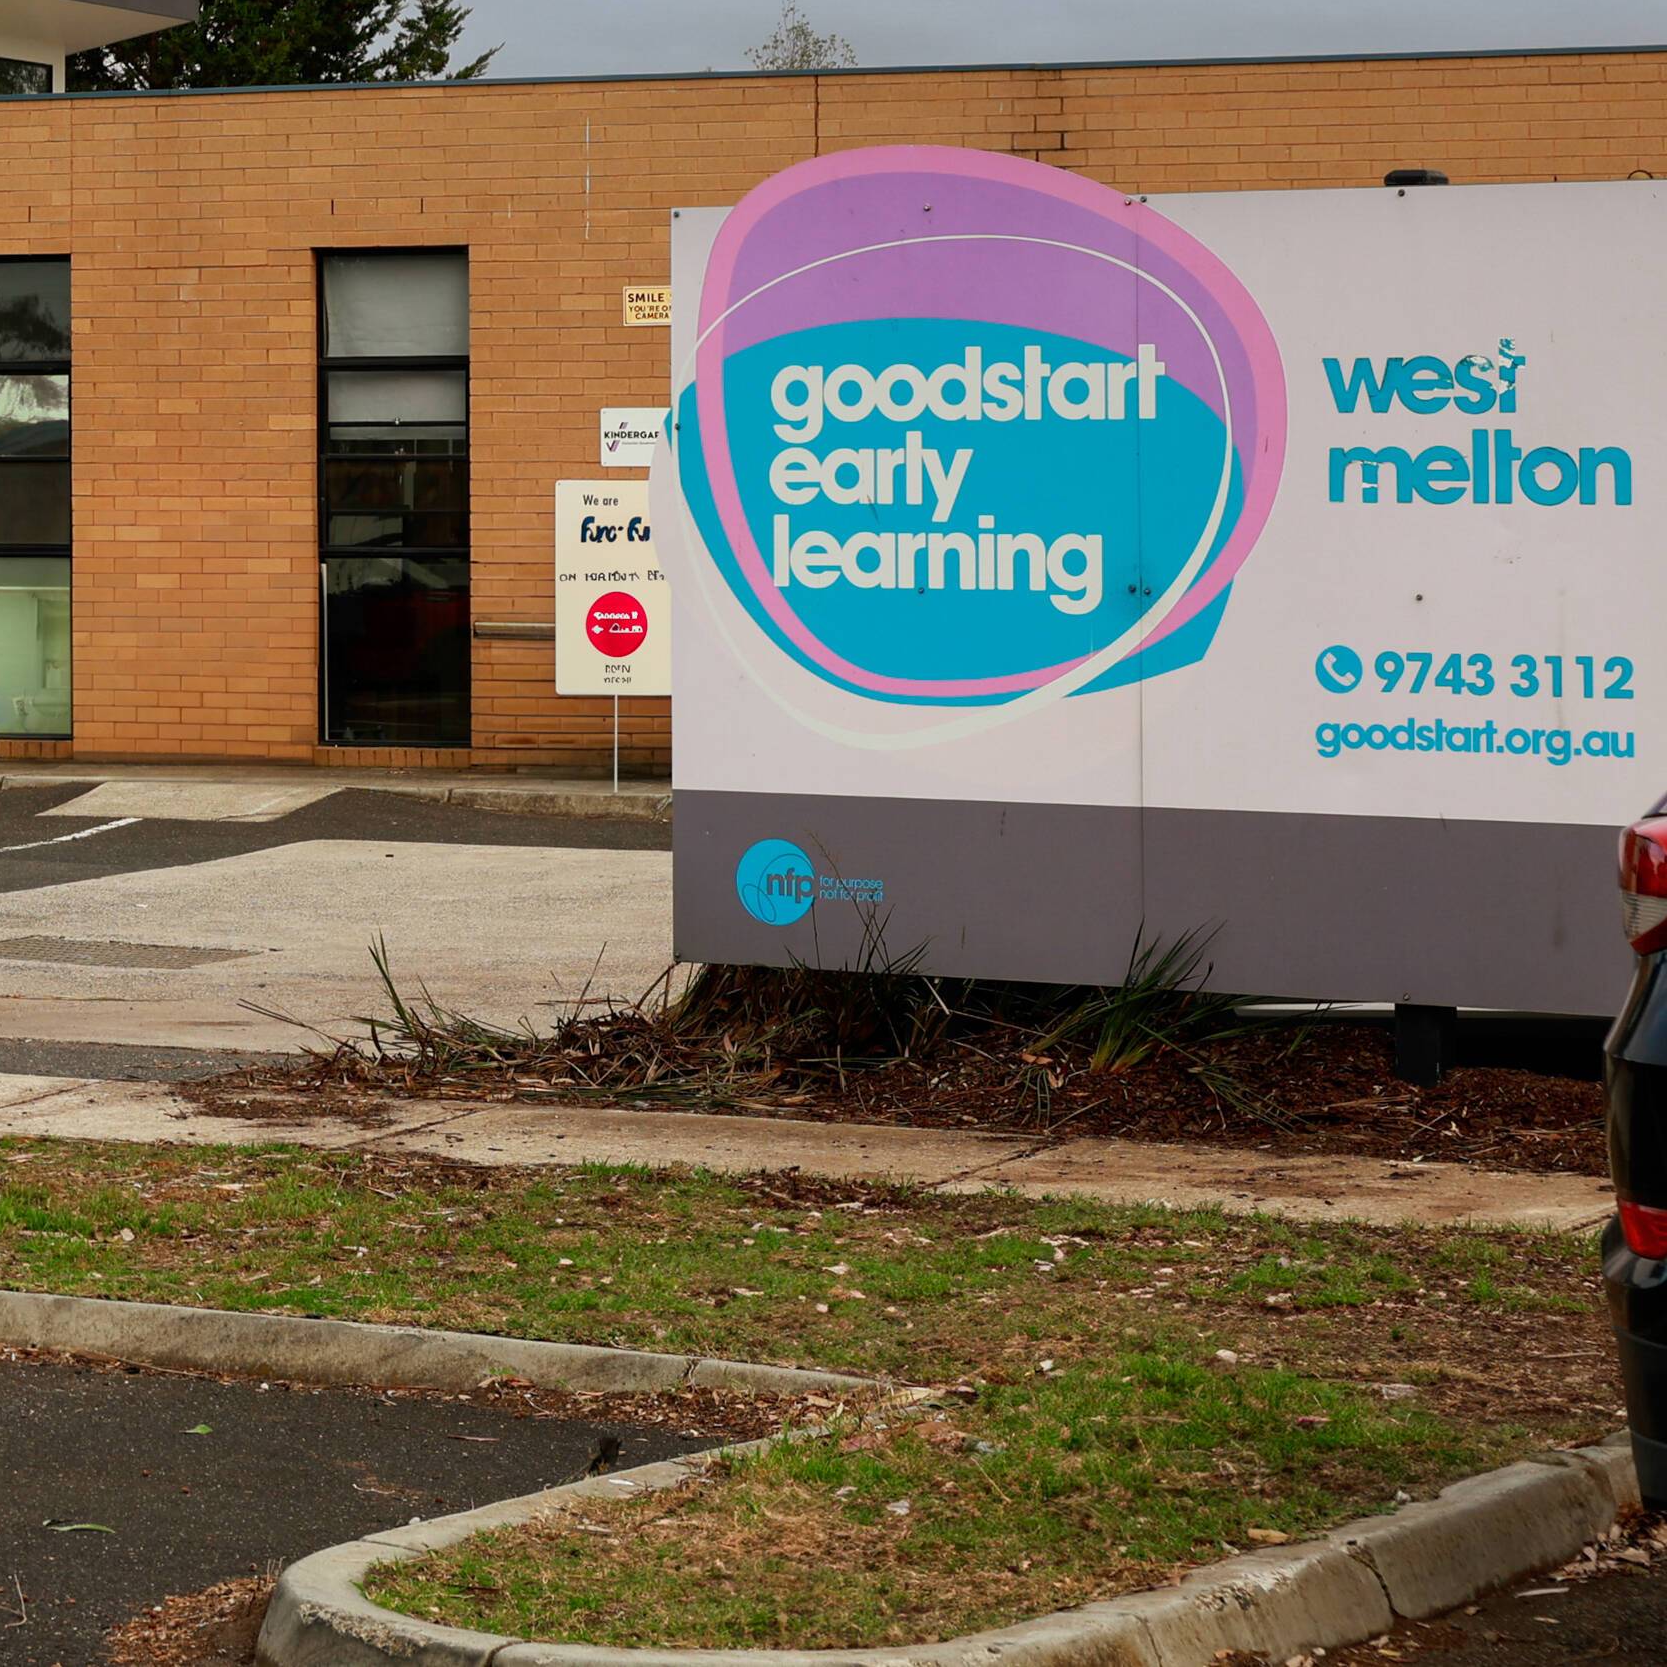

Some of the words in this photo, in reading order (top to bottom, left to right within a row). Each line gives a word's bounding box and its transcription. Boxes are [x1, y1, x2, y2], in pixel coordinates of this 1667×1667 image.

[627, 293, 665, 303] SMILE
[770, 343, 1166, 444] goodstart
[1322, 337, 1526, 415] west
[769, 431, 974, 523] early
[1329, 428, 1632, 506] melton
[583, 494, 599, 506] We
[603, 497, 619, 506] are
[773, 514, 1103, 615] learning
[1374, 651, 1496, 696] 9743
[1510, 654, 1635, 699] 3112
[1315, 717, 1635, 766] goodstart.org.au
[767, 867, 815, 903] nfp
[819, 875, 834, 887] for
[836, 878, 883, 890] purpose
[819, 889, 837, 900] not
[839, 890, 853, 901] for
